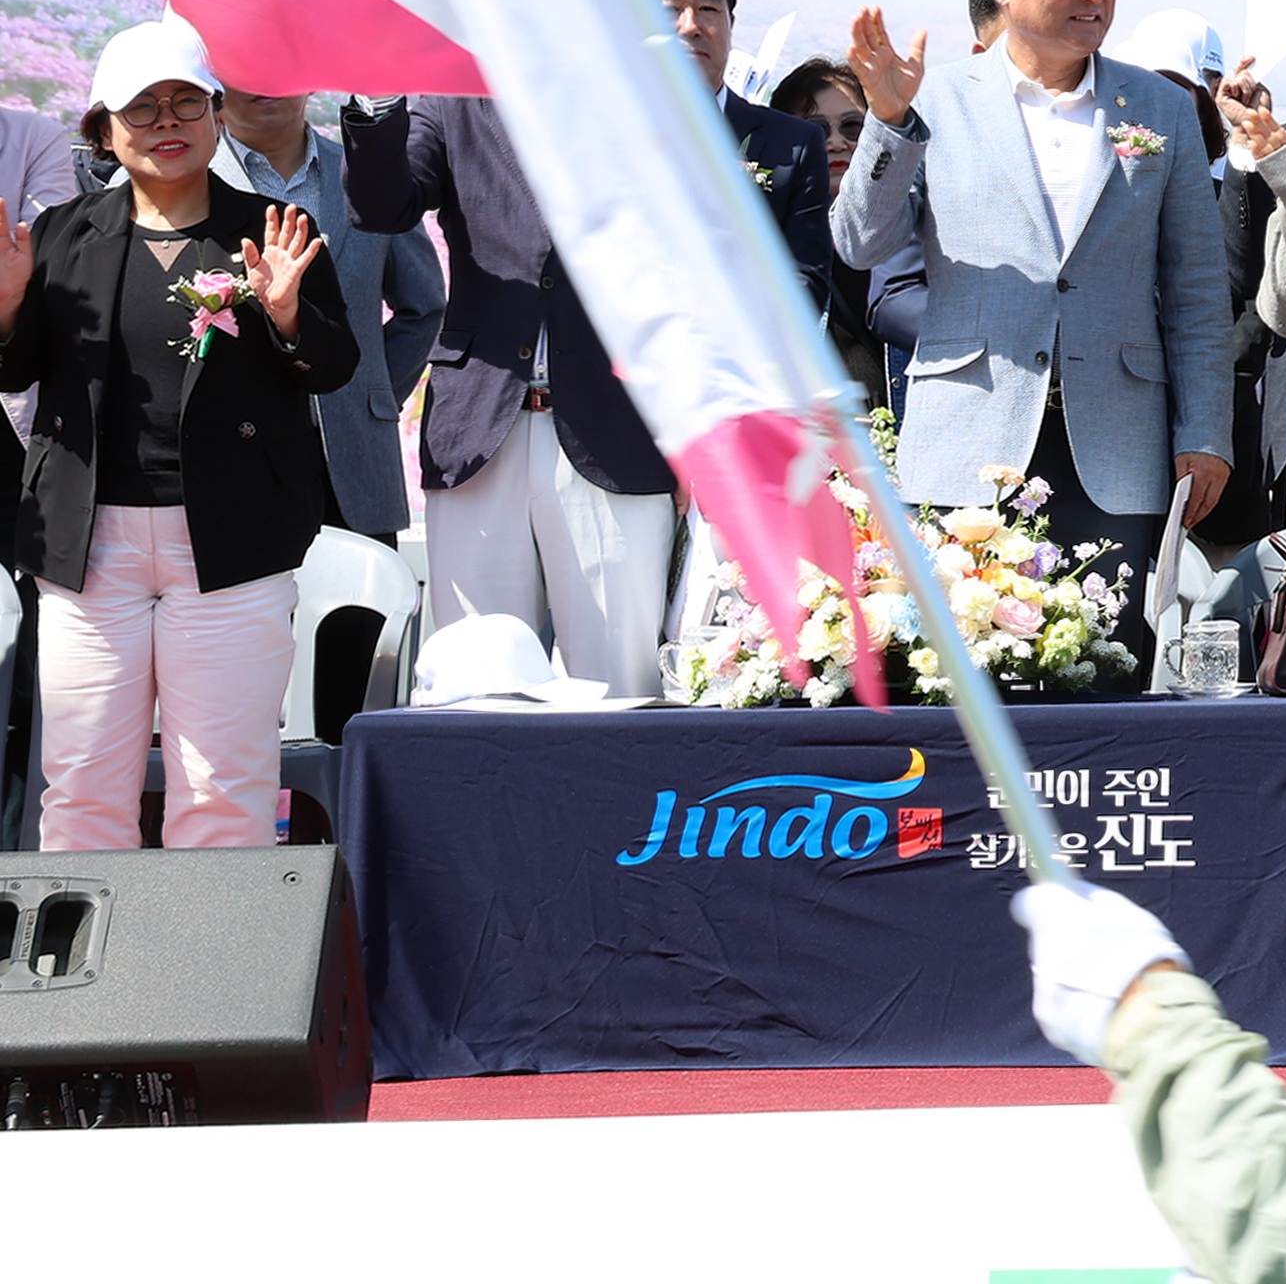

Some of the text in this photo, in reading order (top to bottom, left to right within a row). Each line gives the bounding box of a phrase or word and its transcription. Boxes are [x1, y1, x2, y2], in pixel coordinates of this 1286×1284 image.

[1102, 767, 1171, 808] 주인
[616, 790, 891, 866] Jindo
[1094, 813, 1197, 872] 진도
